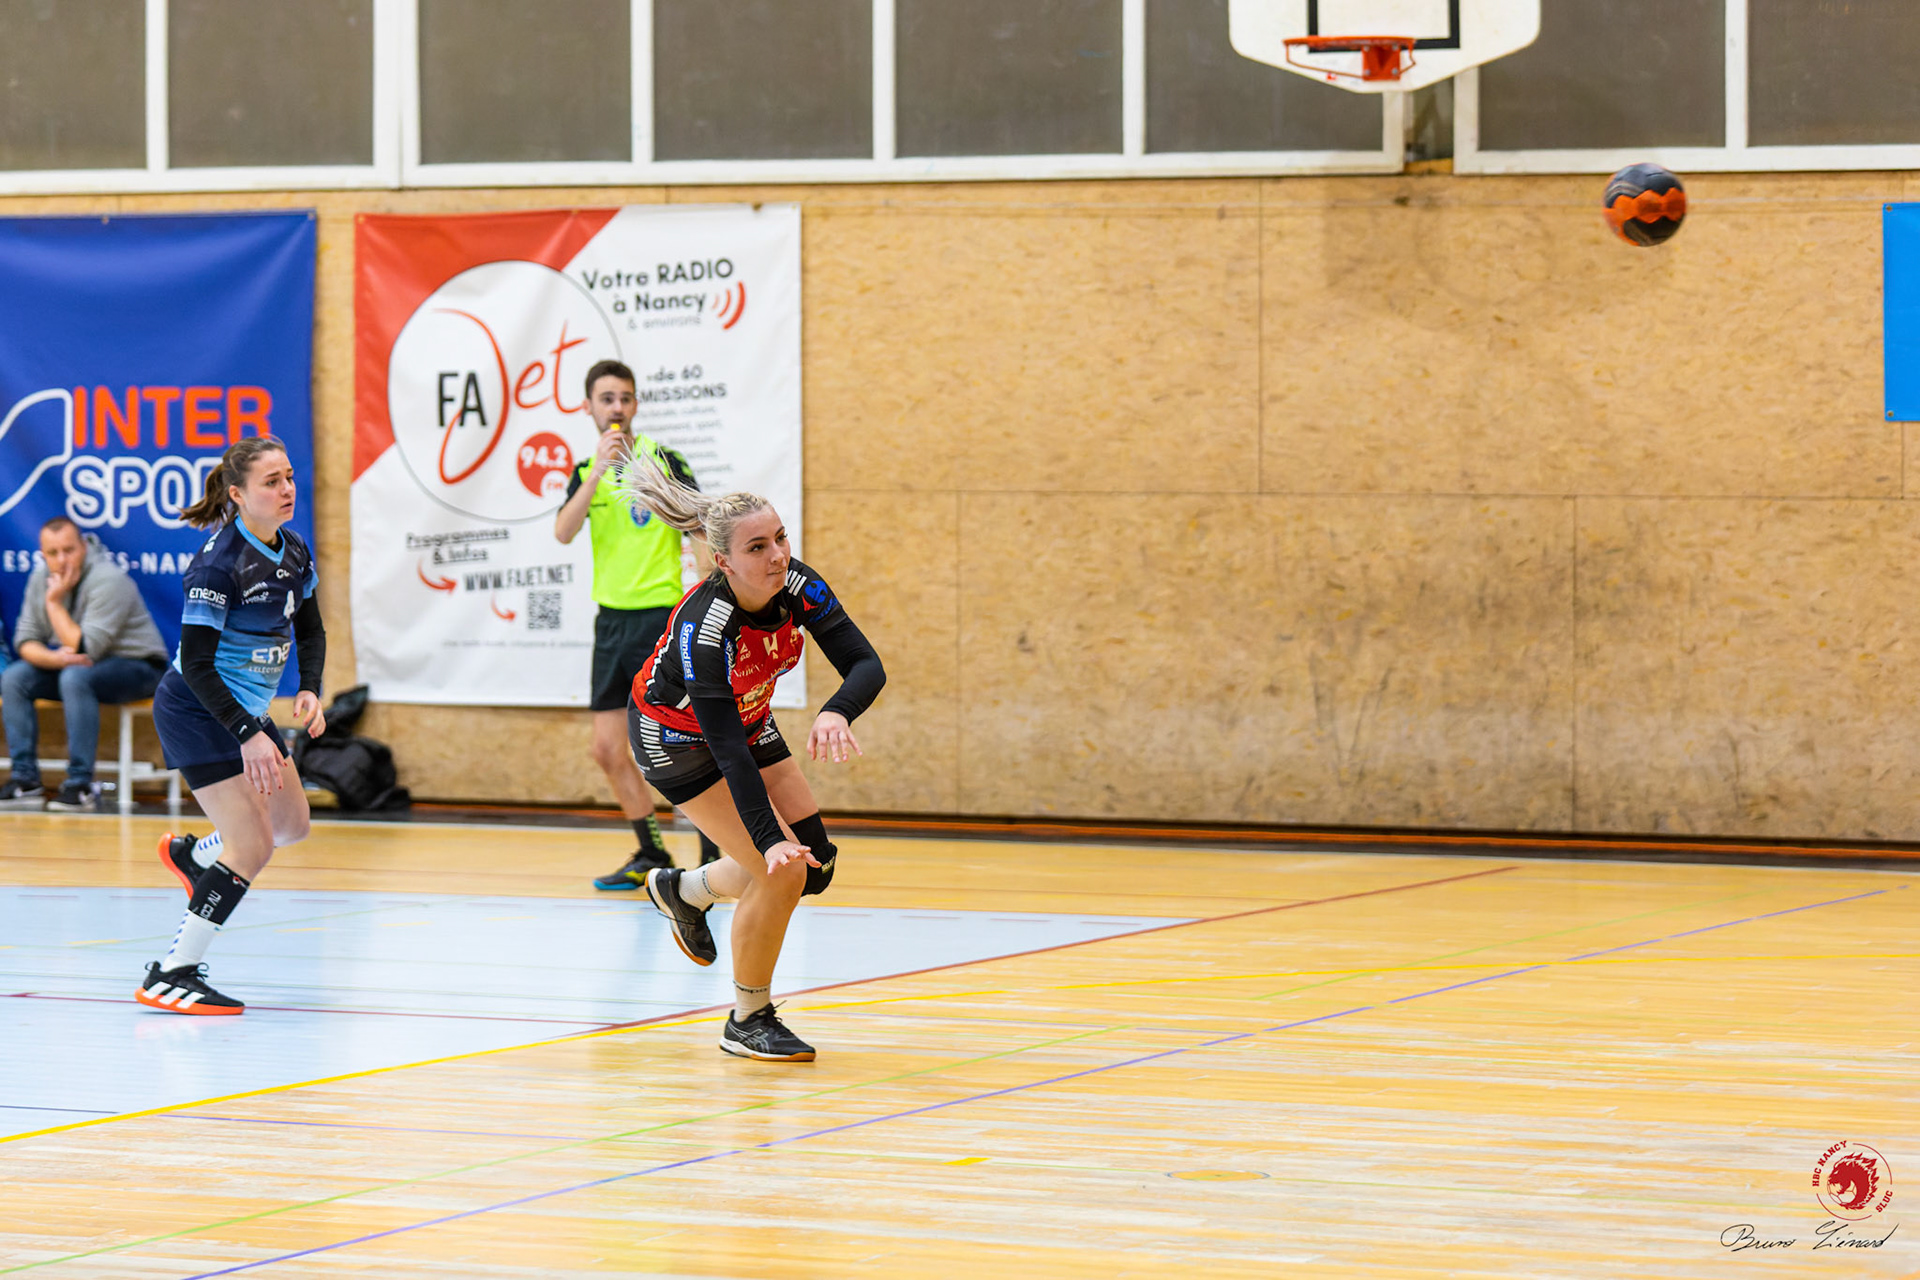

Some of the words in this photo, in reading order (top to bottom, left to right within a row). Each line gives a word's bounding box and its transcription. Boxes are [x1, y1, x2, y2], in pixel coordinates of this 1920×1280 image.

[582, 269, 649, 290] Votre
[657, 257, 734, 284] RADIO
[613, 292, 627, 314] à
[635, 292, 706, 314] Nancy
[73, 385, 273, 449] INTER
[521, 444, 568, 469] 94.2
[406, 528, 509, 548] Programmes
[681, 622, 694, 659] Grand
[683, 660, 694, 679] Est
